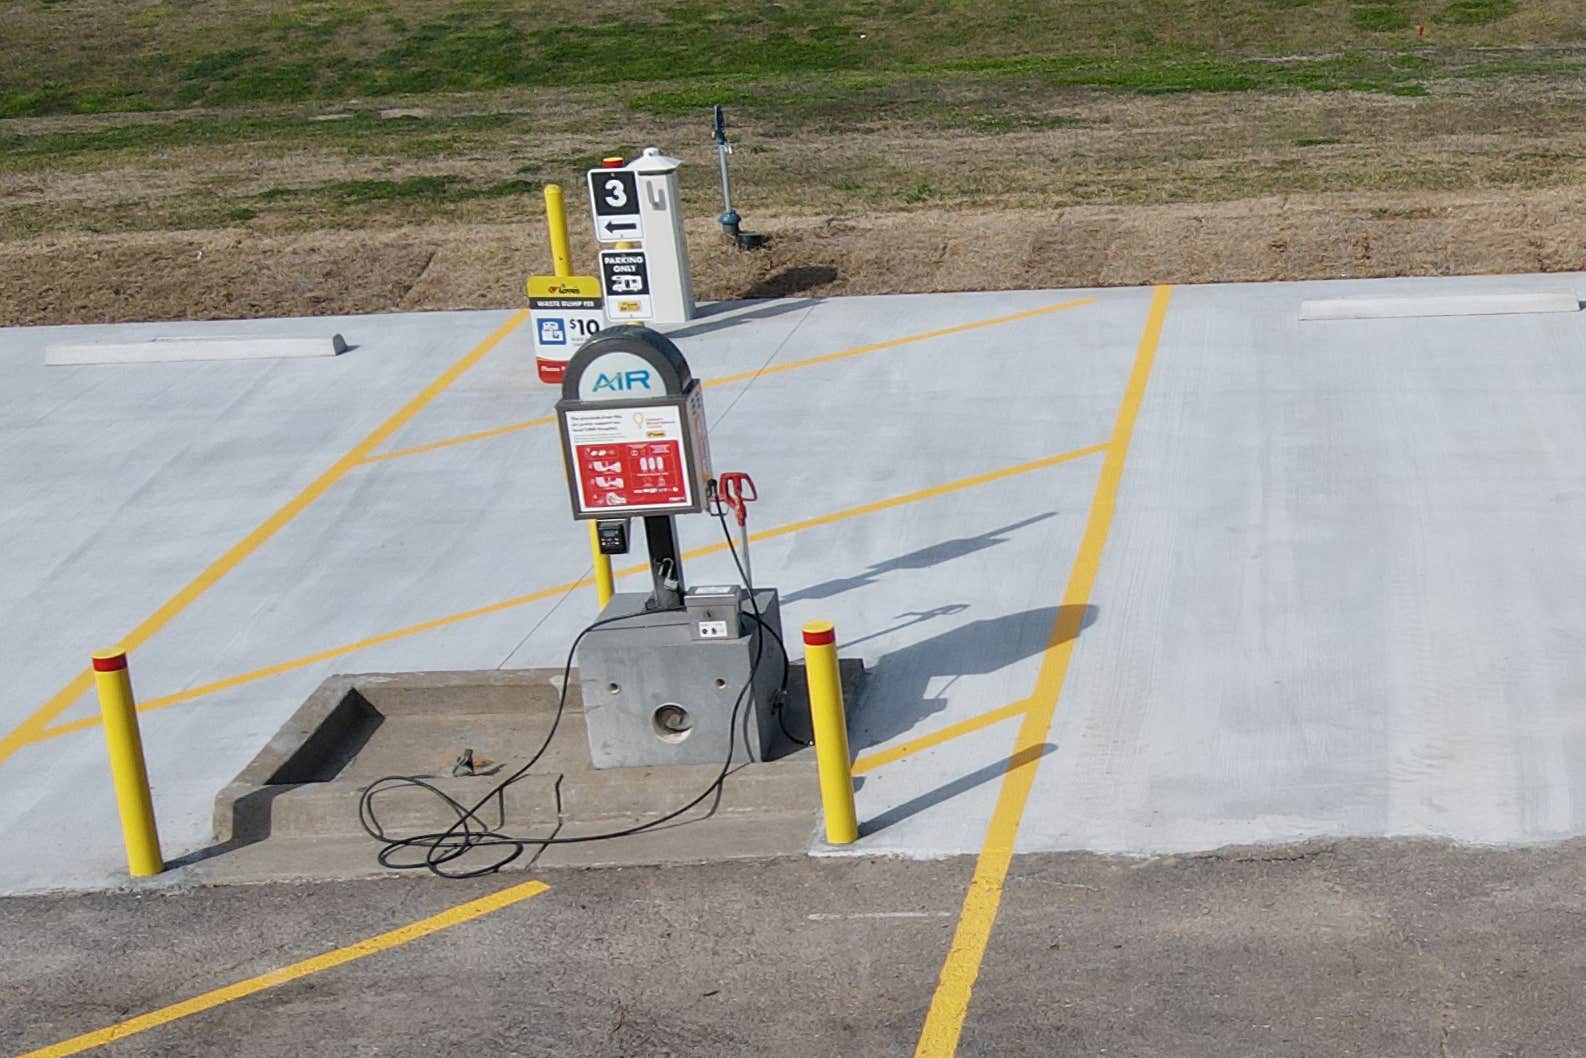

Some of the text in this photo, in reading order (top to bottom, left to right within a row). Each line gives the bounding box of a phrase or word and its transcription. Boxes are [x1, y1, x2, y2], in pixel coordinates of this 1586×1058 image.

[603, 179, 628, 208] 3
[604, 256, 644, 265] PARKING
[612, 264, 636, 273] ONLY
[569, 318, 600, 336] $10
[592, 370, 651, 393] AIR
